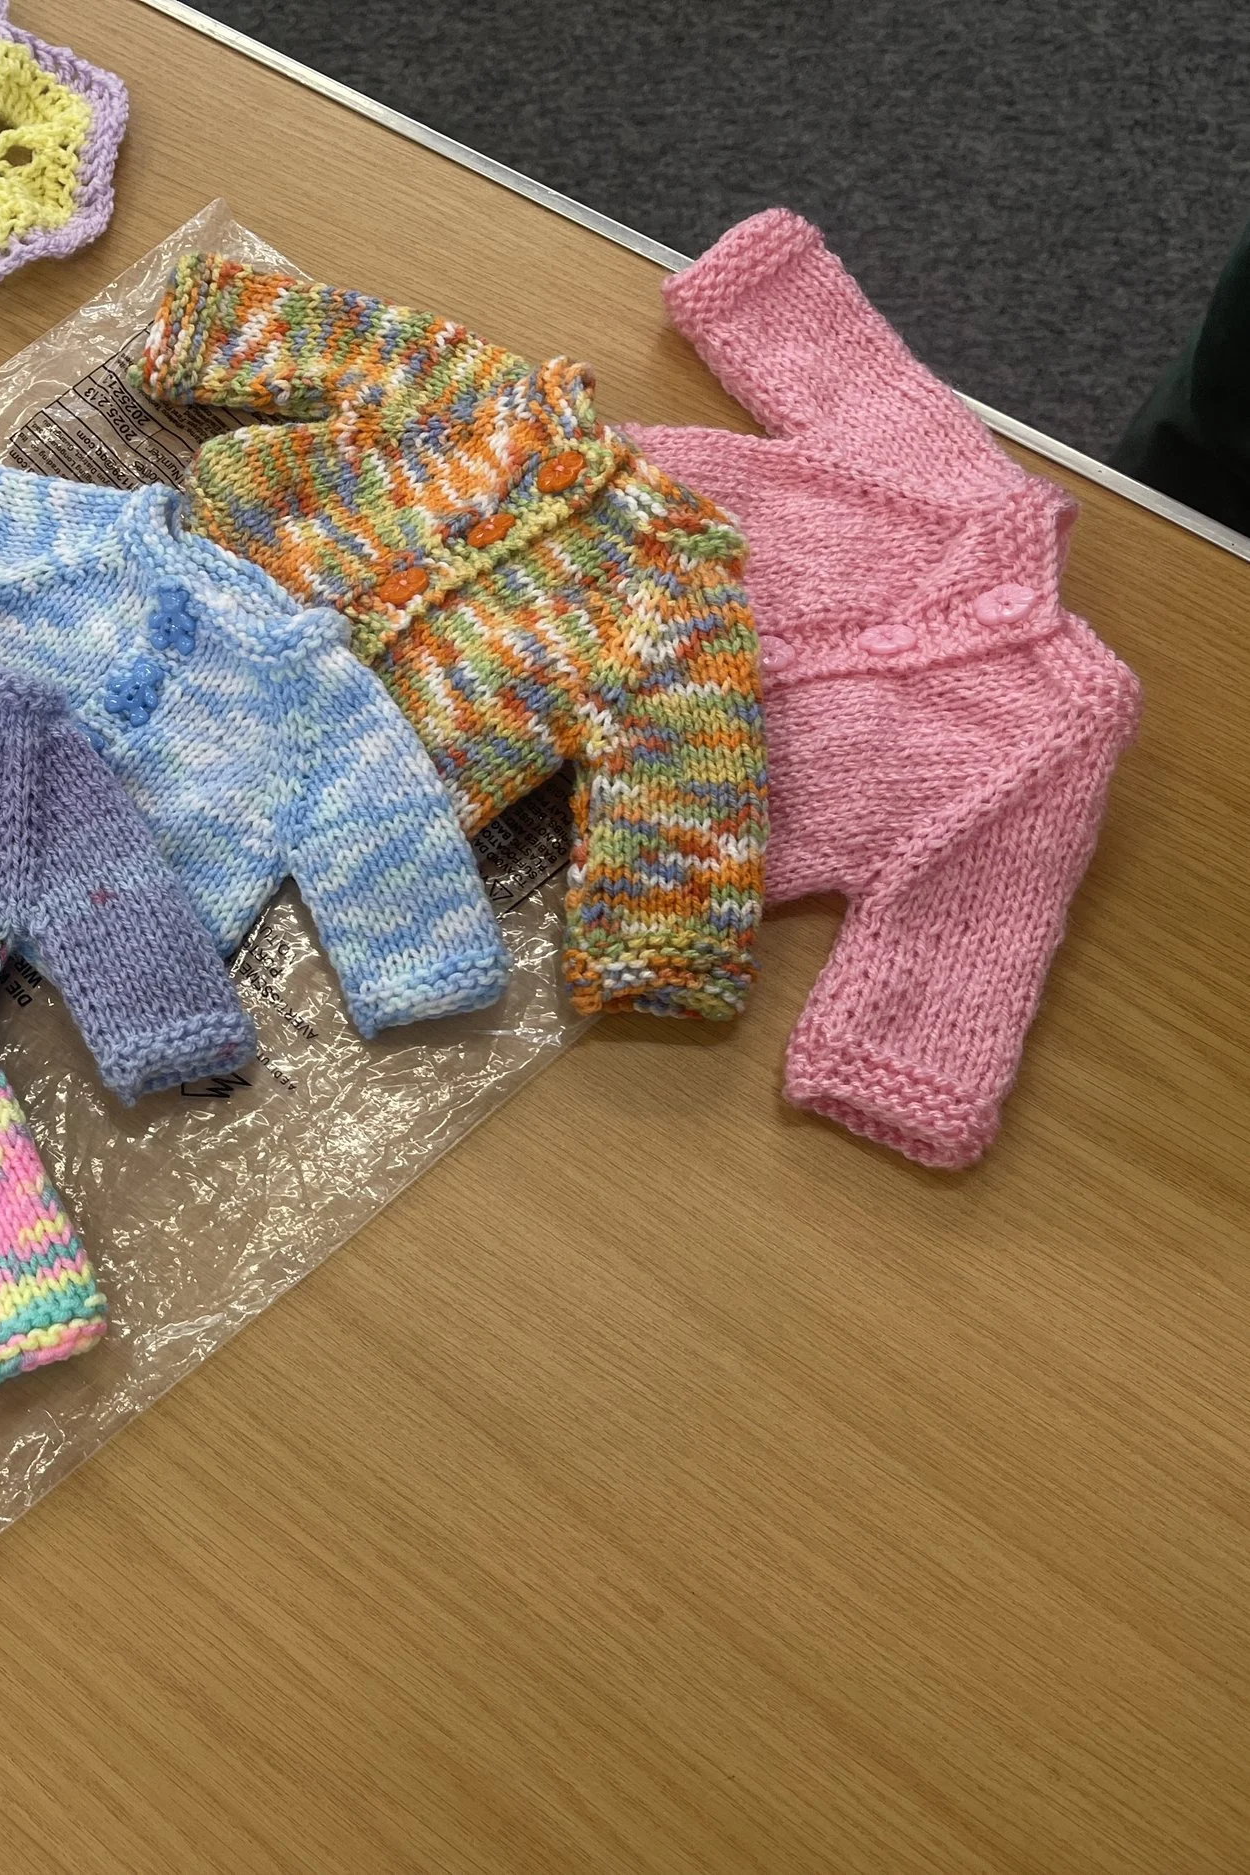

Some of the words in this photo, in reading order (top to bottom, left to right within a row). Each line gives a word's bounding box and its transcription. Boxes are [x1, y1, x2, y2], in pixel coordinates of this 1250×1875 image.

[83, 384, 137, 441] 2025.2.13
[37, 449, 61, 474] trading
[74, 429, 136, 491] 1129@qq.com
[130, 459, 162, 488] lothes
[490, 819, 511, 840] BAG
[480, 827, 538, 880] SUFFOCATIO
[524, 832, 557, 863] BABIES
[4, 979, 33, 1008] DIE
[235, 959, 319, 1042] AVERTISSEME
